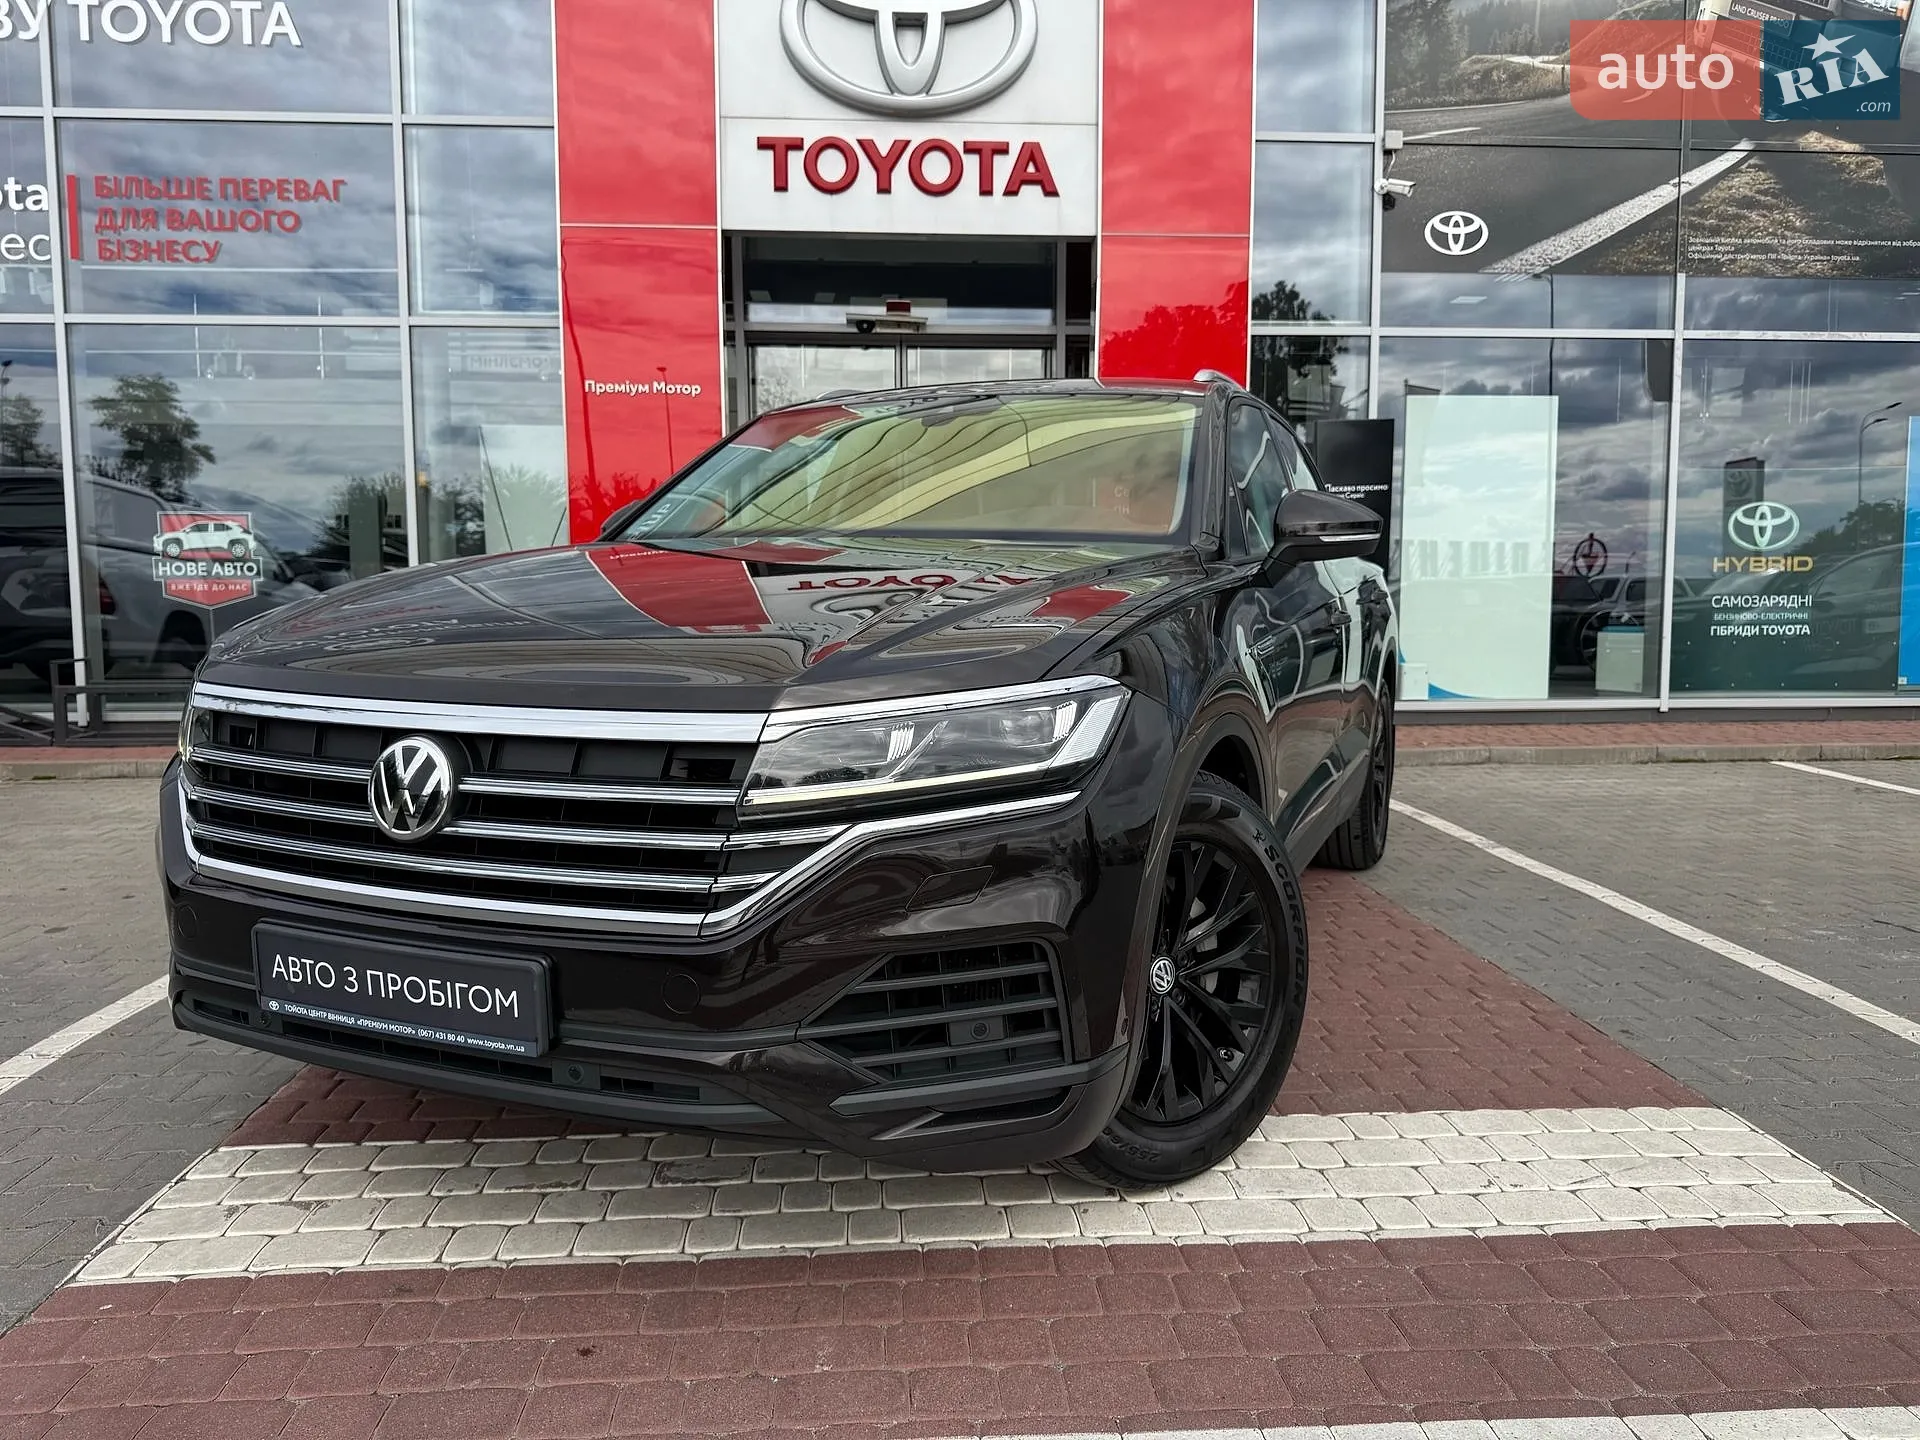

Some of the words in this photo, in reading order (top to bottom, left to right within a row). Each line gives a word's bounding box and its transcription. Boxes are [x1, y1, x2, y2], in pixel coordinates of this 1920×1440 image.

[67, 0, 302, 46] TOYOTA
[757, 135, 1060, 196] TOYOTA
[94, 175, 211, 200] БІЛЬШЕ
[219, 177, 346, 202] ПЕРЕВАГ
[95, 207, 158, 234] ДЛЯ
[166, 208, 301, 233] ВАШОГО
[98, 239, 221, 263] БІЗНЕСУ
[585, 380, 650, 397] Преміум
[653, 381, 701, 397] Мотор
[1357, 484, 1389, 493] просимо
[158, 561, 207, 576] НОВЕ
[211, 561, 258, 576] АВТО
[1712, 556, 1814, 573] HYBRID
[212, 583, 225, 592] ДО
[228, 583, 248, 591] НАС
[1711, 594, 1812, 609] САМОЗАРЯДНІ
[1713, 612, 1809, 621] БЕНЗИНОВО-ЕЛЕКТРИЧНІ
[1710, 625, 1760, 638] ГІБРИДИ
[1761, 624, 1811, 636] TOYOTA
[272, 953, 335, 989] АВТО
[367, 969, 519, 1018] ПРОБІГОМ
[284, 1004, 308, 1015] ТОЙОТА
[308, 1009, 327, 1019] ЦЕНТР
[327, 1012, 355, 1024] ВІННИЦЯ
[417, 1028, 435, 1039] (067)
[435, 1031, 447, 1040] 431
[447, 1033, 456, 1042] 80
[456, 1035, 465, 1043] 40
[466, 1037, 525, 1053] www.toyota.vn.ua
